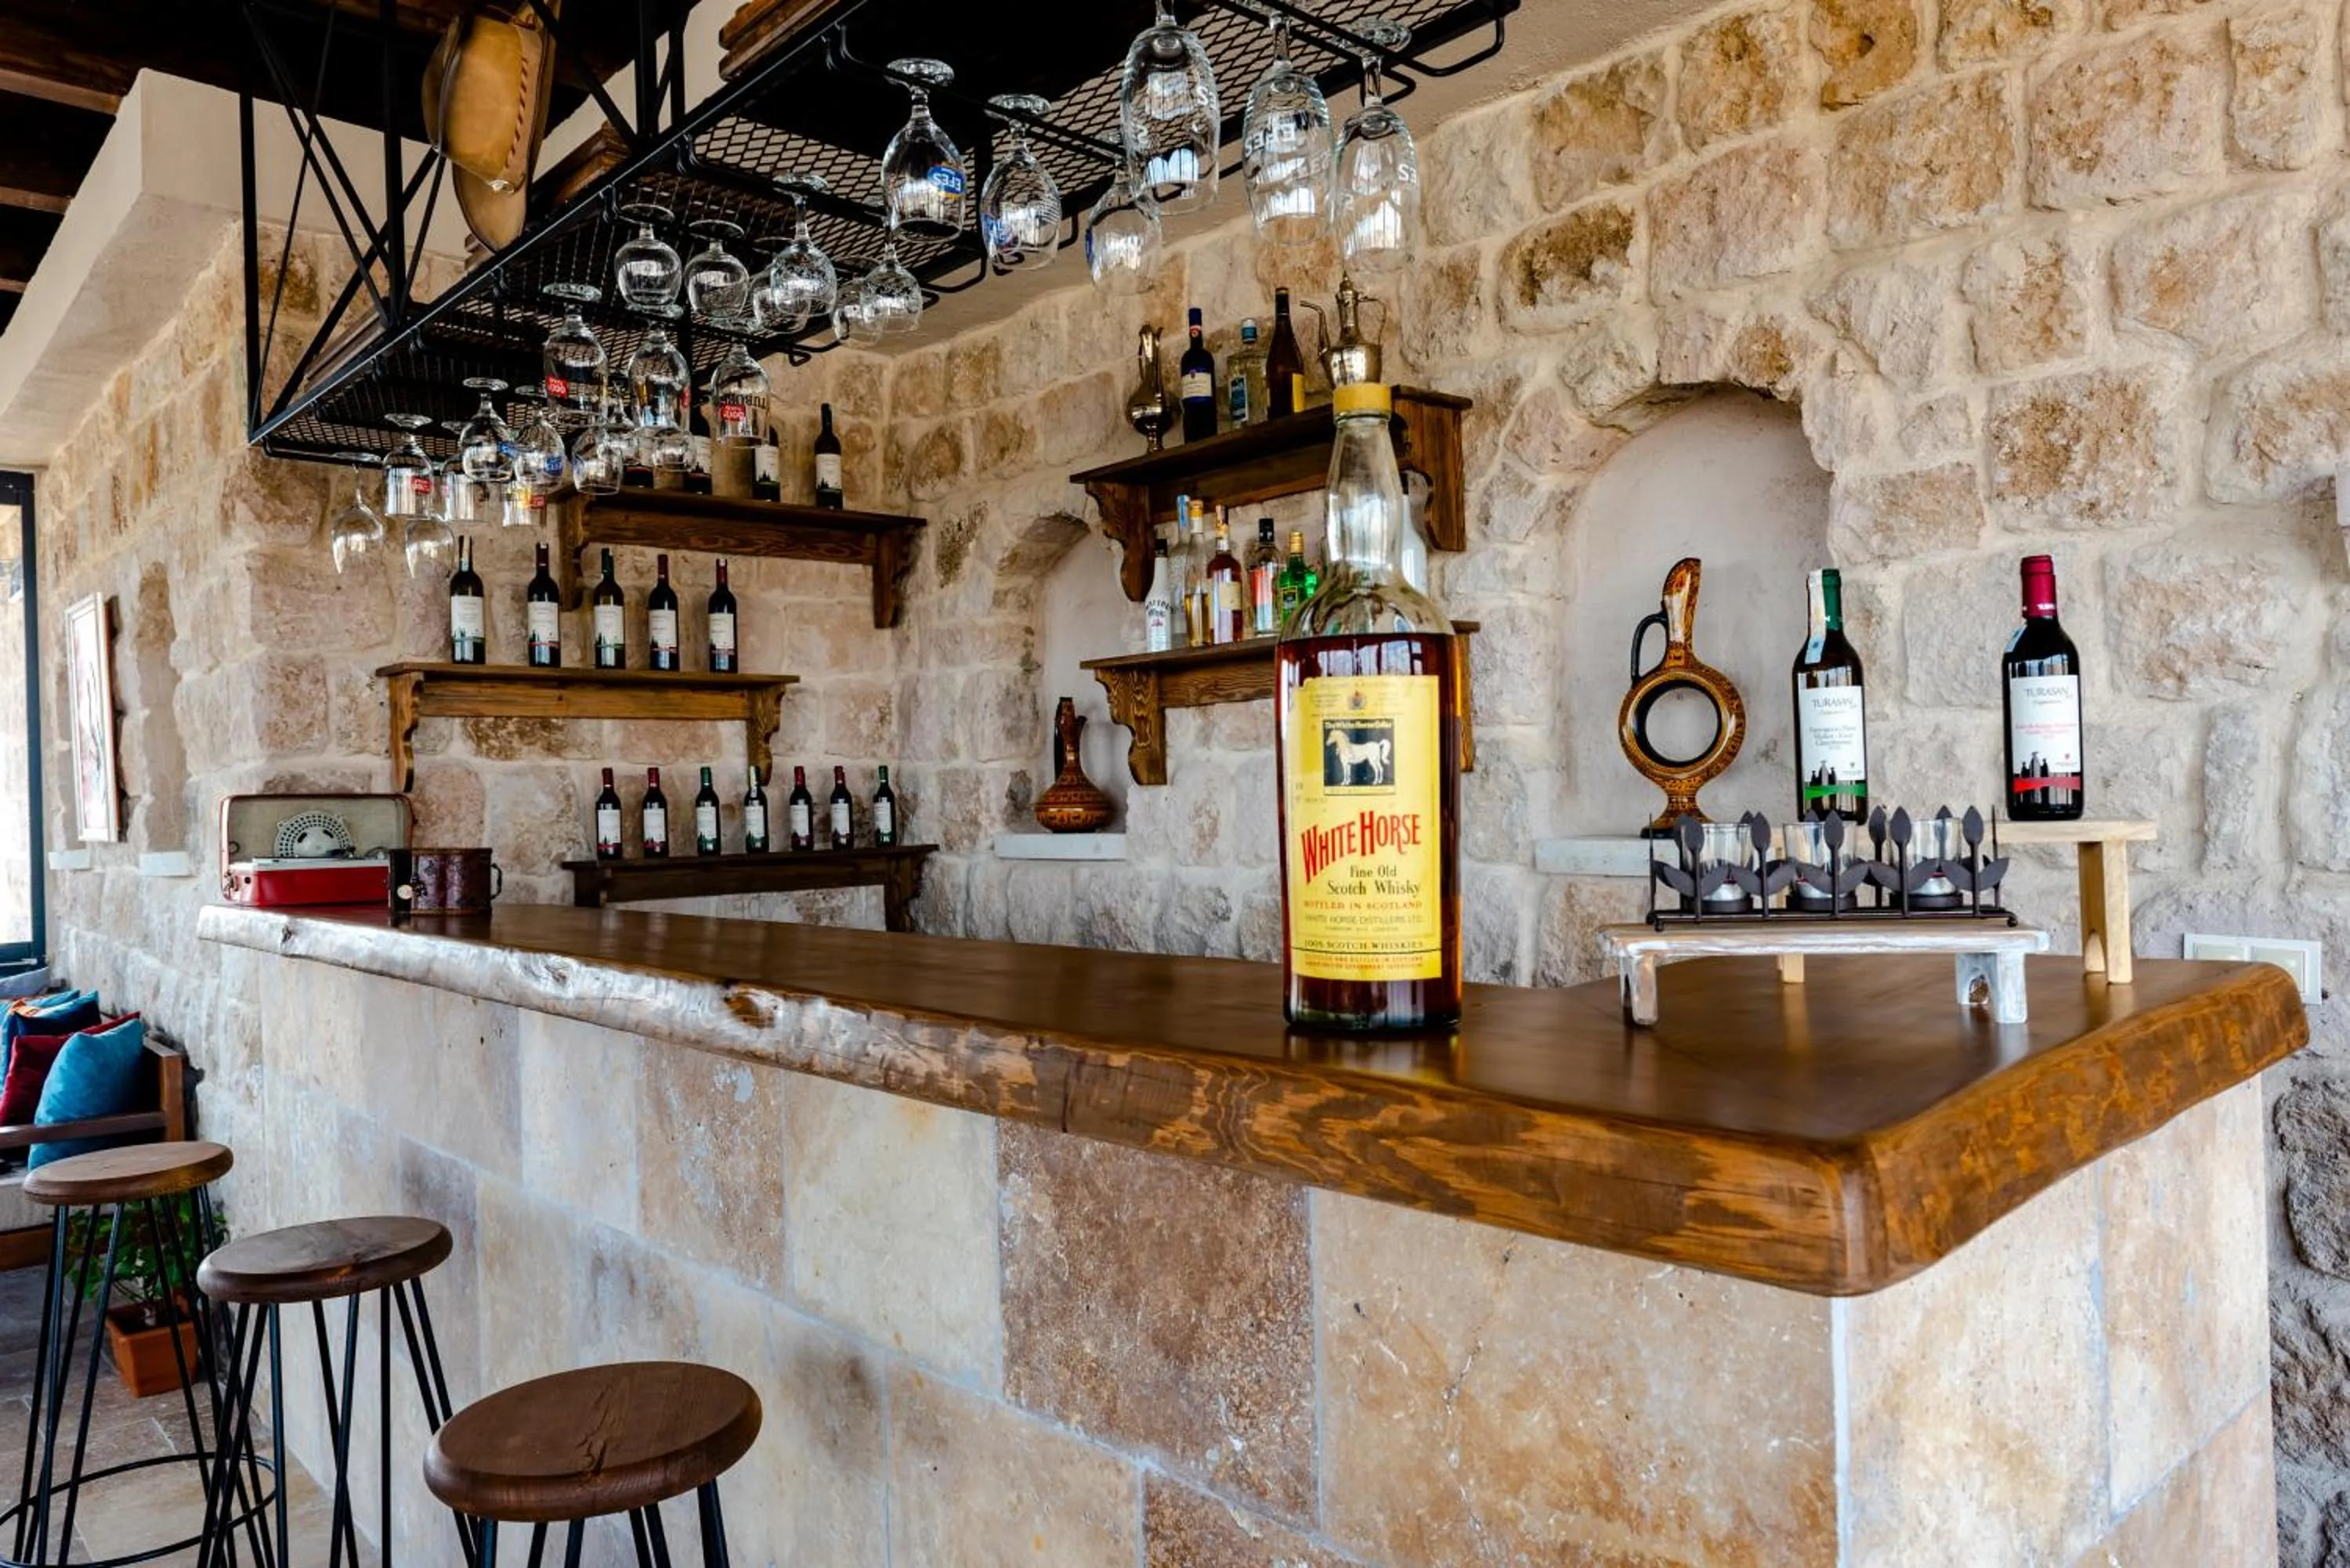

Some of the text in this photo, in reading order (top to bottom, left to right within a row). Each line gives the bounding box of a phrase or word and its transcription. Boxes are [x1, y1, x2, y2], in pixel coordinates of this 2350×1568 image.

[1245, 123, 1296, 157] EFES
[933, 173, 962, 193] EFES
[1301, 811, 1421, 883] WHITE HORSE
[1350, 865, 1397, 878] Fine Old
[1328, 880, 1420, 898] Scotch Whisky
[1303, 900, 1423, 910] BOTTLED IN SCOTLAND
[1326, 940, 1367, 950] SCOTCH
